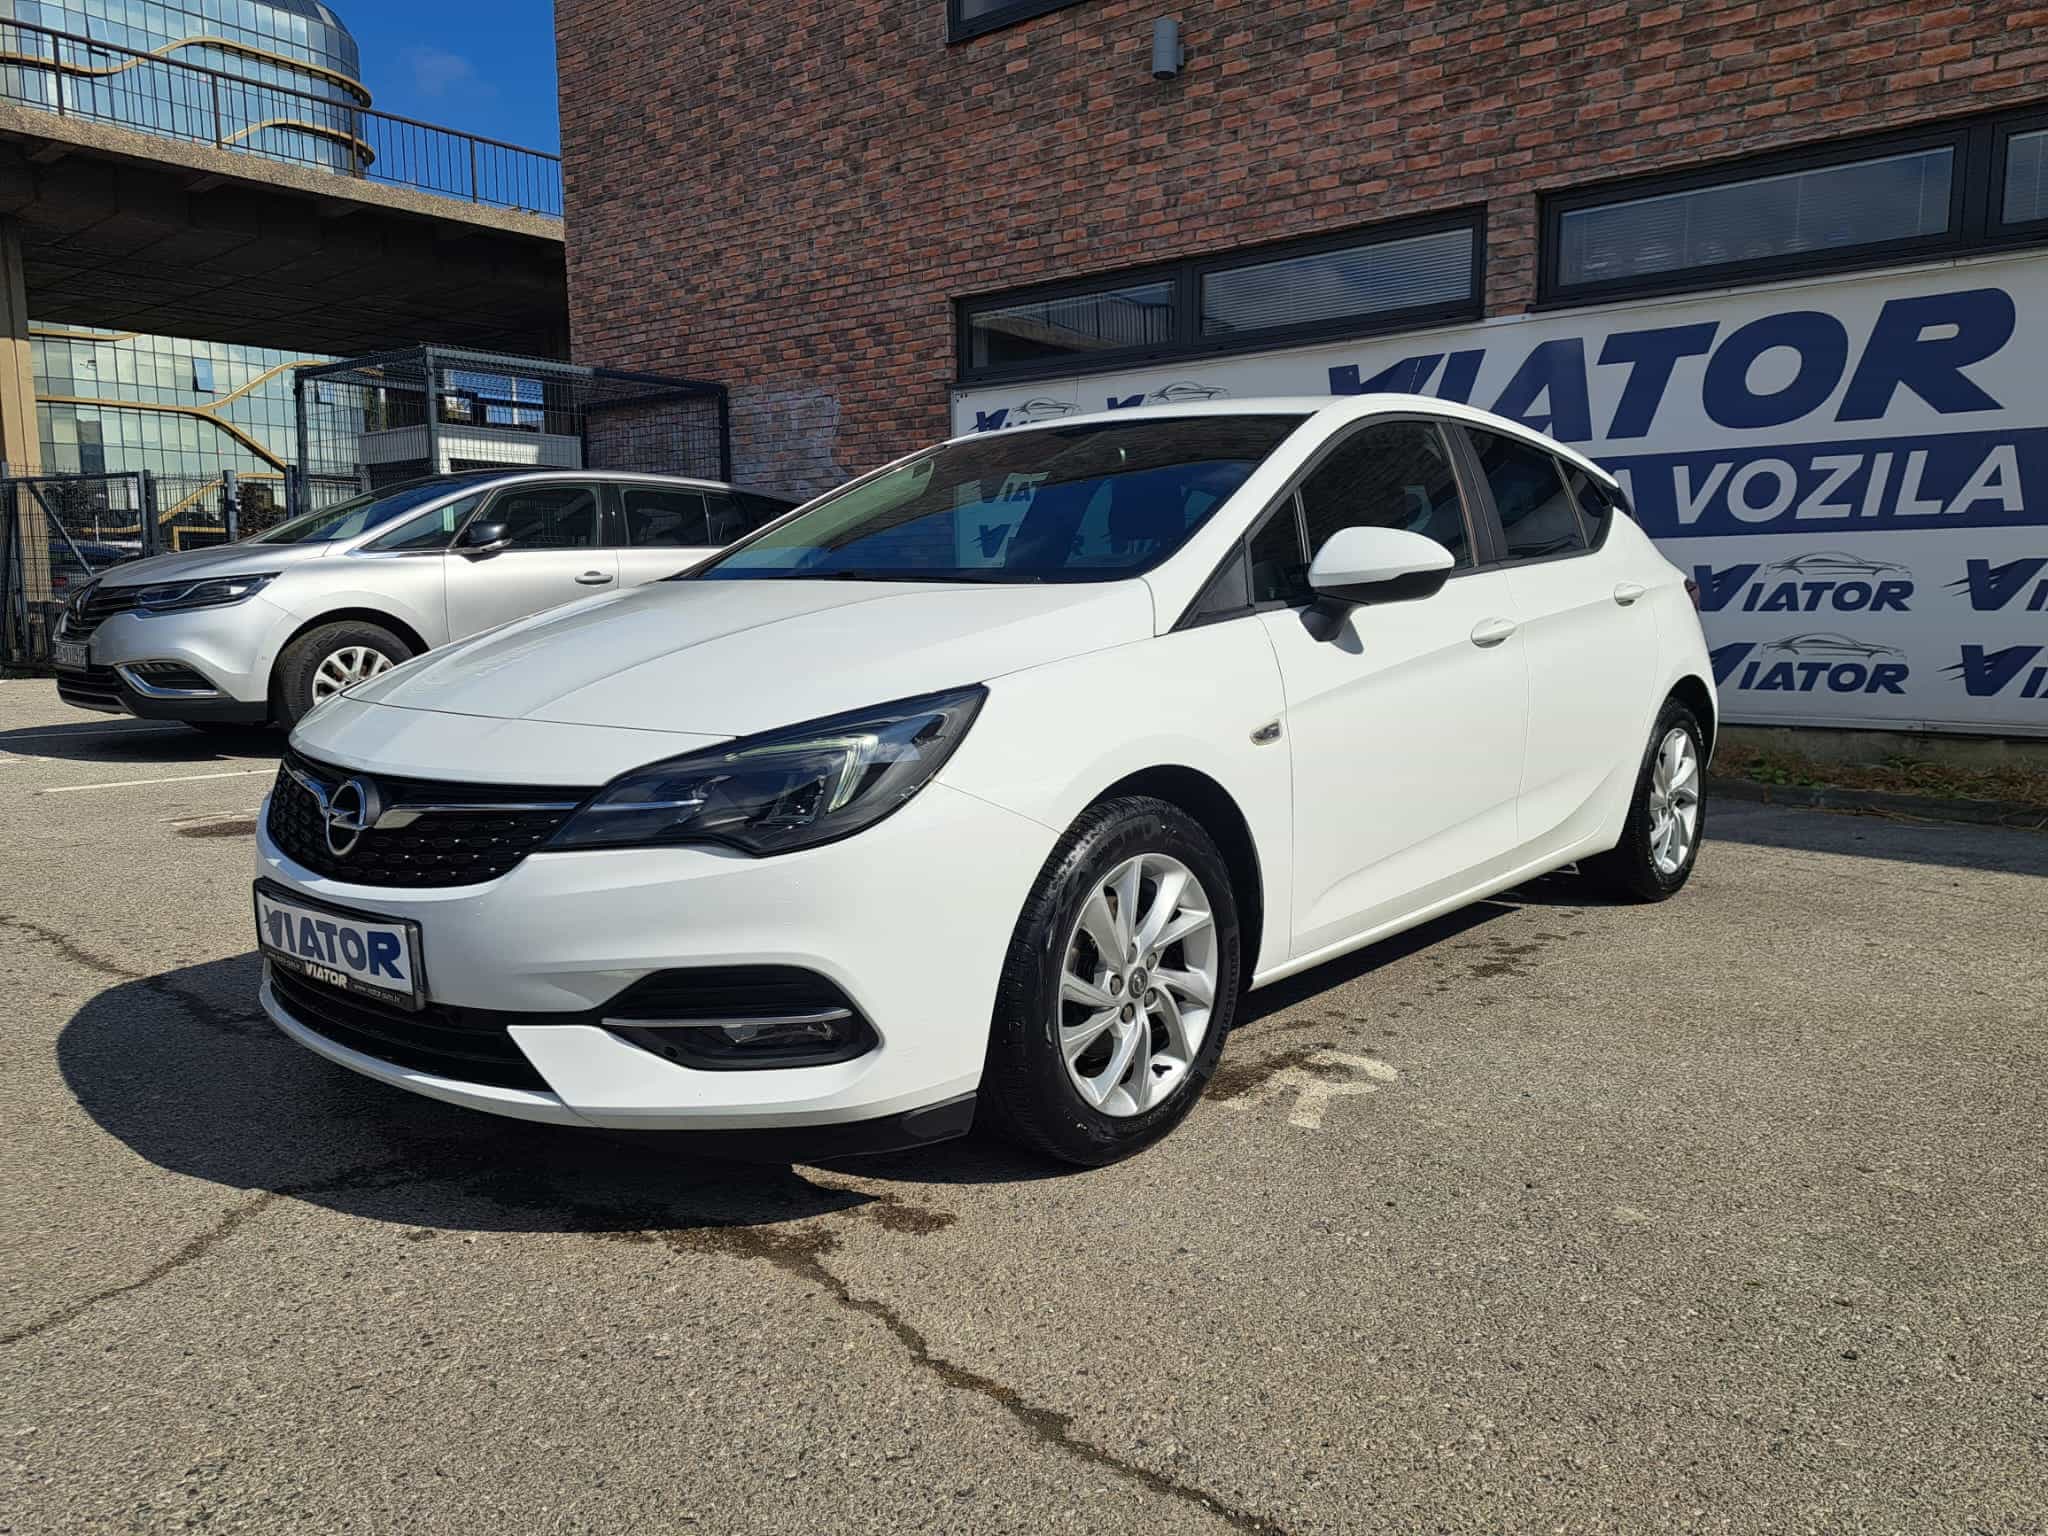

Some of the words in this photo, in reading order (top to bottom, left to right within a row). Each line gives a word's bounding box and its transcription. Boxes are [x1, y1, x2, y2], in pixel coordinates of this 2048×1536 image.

[1672, 445, 2025, 524] VOZILA
[1693, 563, 1914, 612] VIATOR
[266, 906, 405, 980] VIATOR
[304, 961, 348, 989] VIATOR
